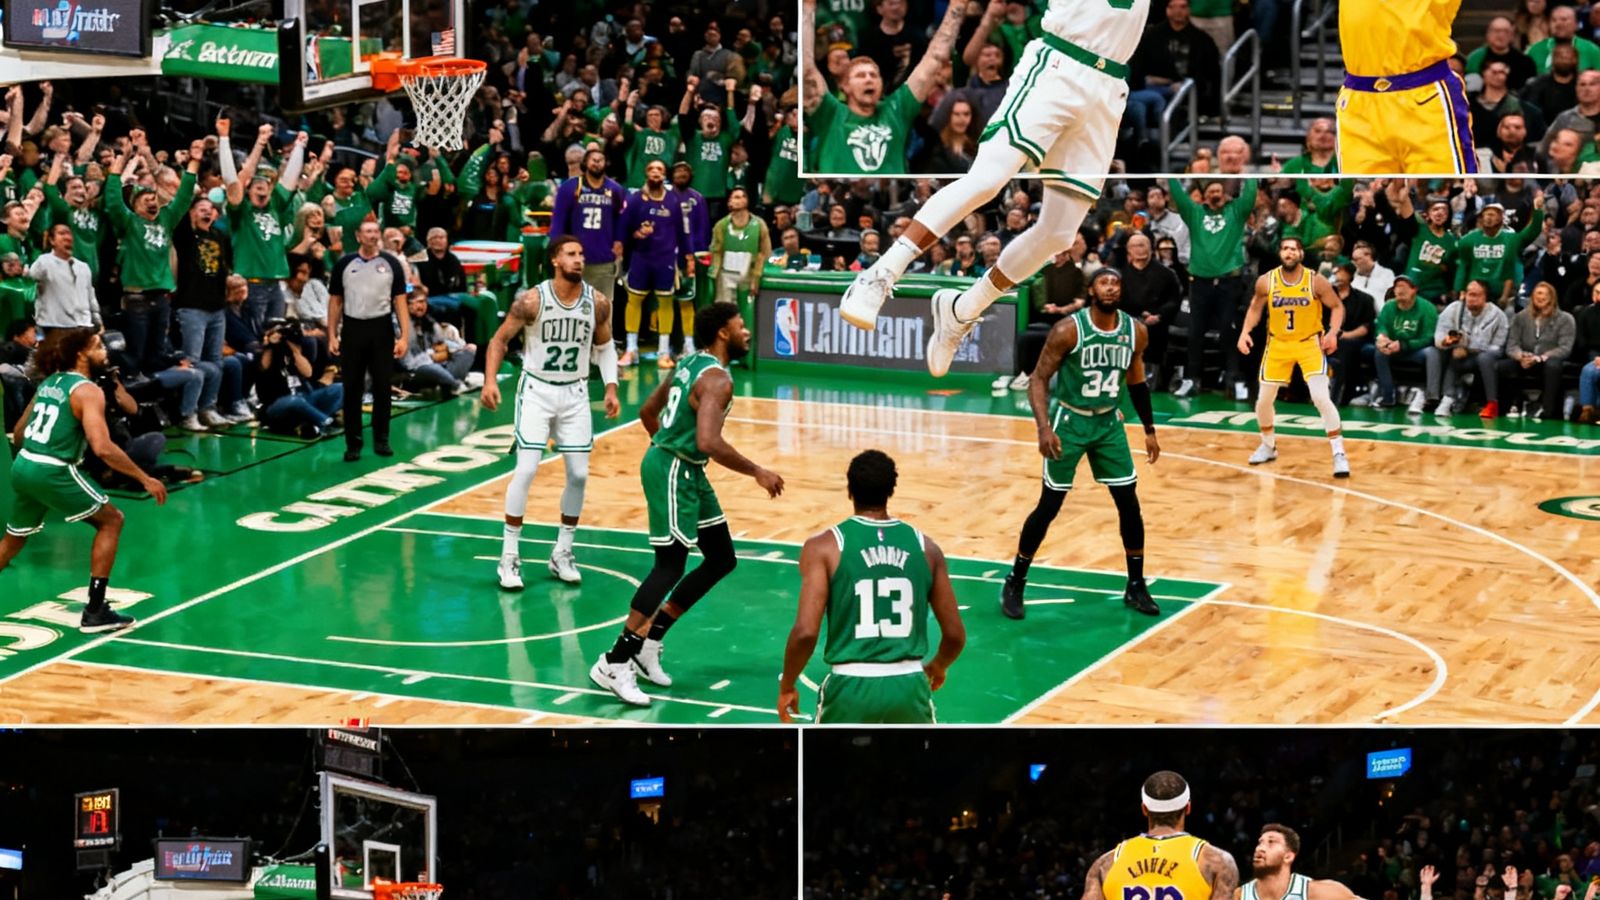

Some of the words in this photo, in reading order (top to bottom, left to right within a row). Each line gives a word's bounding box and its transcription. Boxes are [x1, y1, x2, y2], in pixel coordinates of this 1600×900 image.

[541, 345, 579, 372] 23
[1081, 369, 1120, 398] 34
[854, 576, 914, 639] 13
